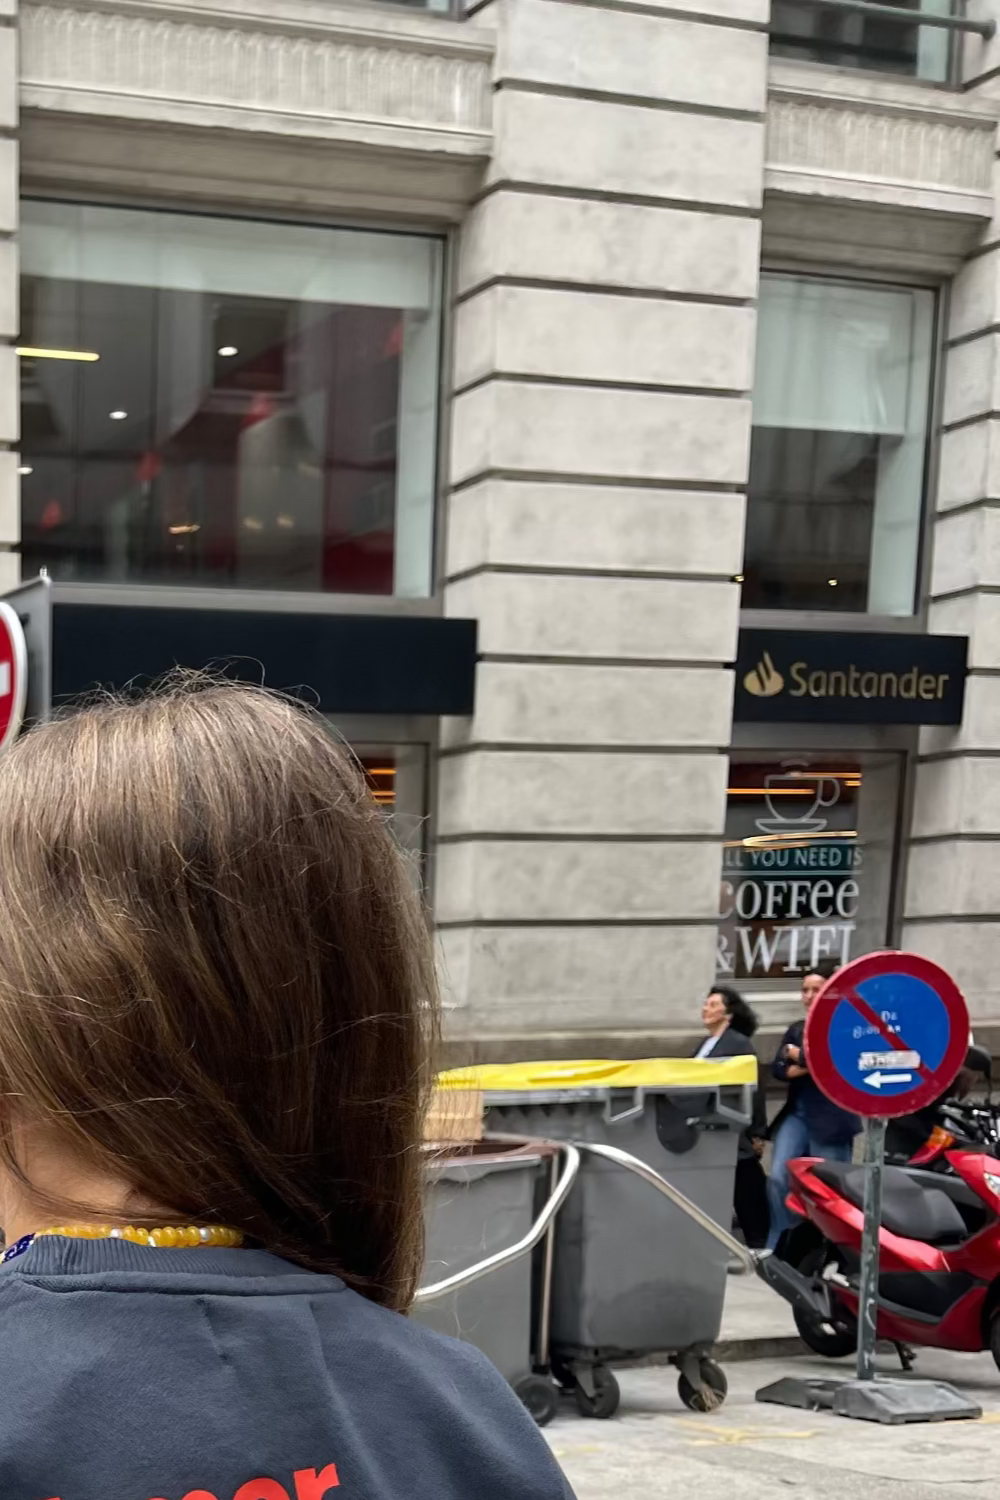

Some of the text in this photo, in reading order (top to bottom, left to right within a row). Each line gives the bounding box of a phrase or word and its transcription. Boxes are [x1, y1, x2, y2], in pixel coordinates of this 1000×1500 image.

[788, 662, 949, 700] Santander
[725, 846, 863, 867] LL YOU NEED IS
[734, 922, 857, 973] WIFI
